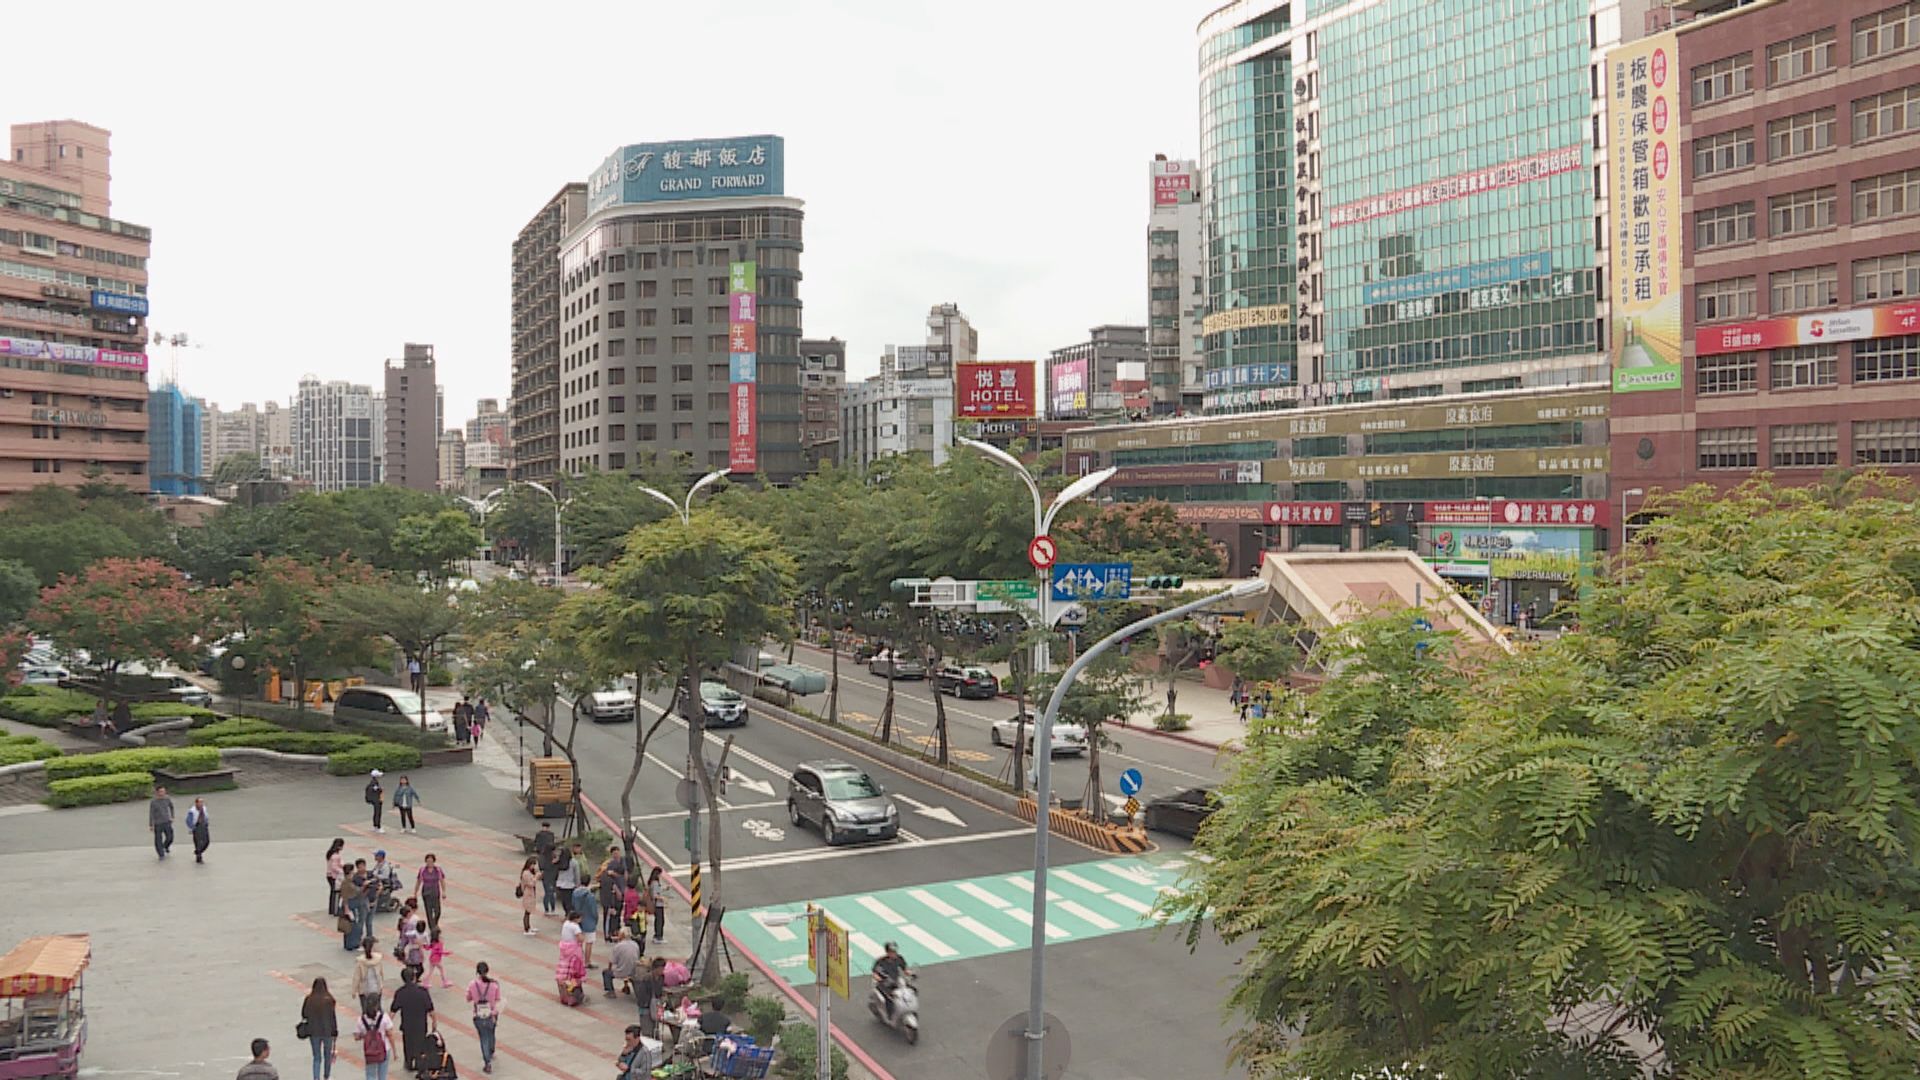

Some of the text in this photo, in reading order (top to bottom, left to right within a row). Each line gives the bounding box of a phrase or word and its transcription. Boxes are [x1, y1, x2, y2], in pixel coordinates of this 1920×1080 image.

[661, 145, 765, 170] 馥都飯店
[660, 174, 765, 192] GRAND FORWARD
[1630, 56, 1651, 301] 板農保管箱歡迎承租
[975, 369, 1016, 387] 悅喜
[970, 390, 1024, 402] HOTEL
[1446, 405, 1493, 424] 原素食府
[1449, 454, 1495, 471] 原素食府
